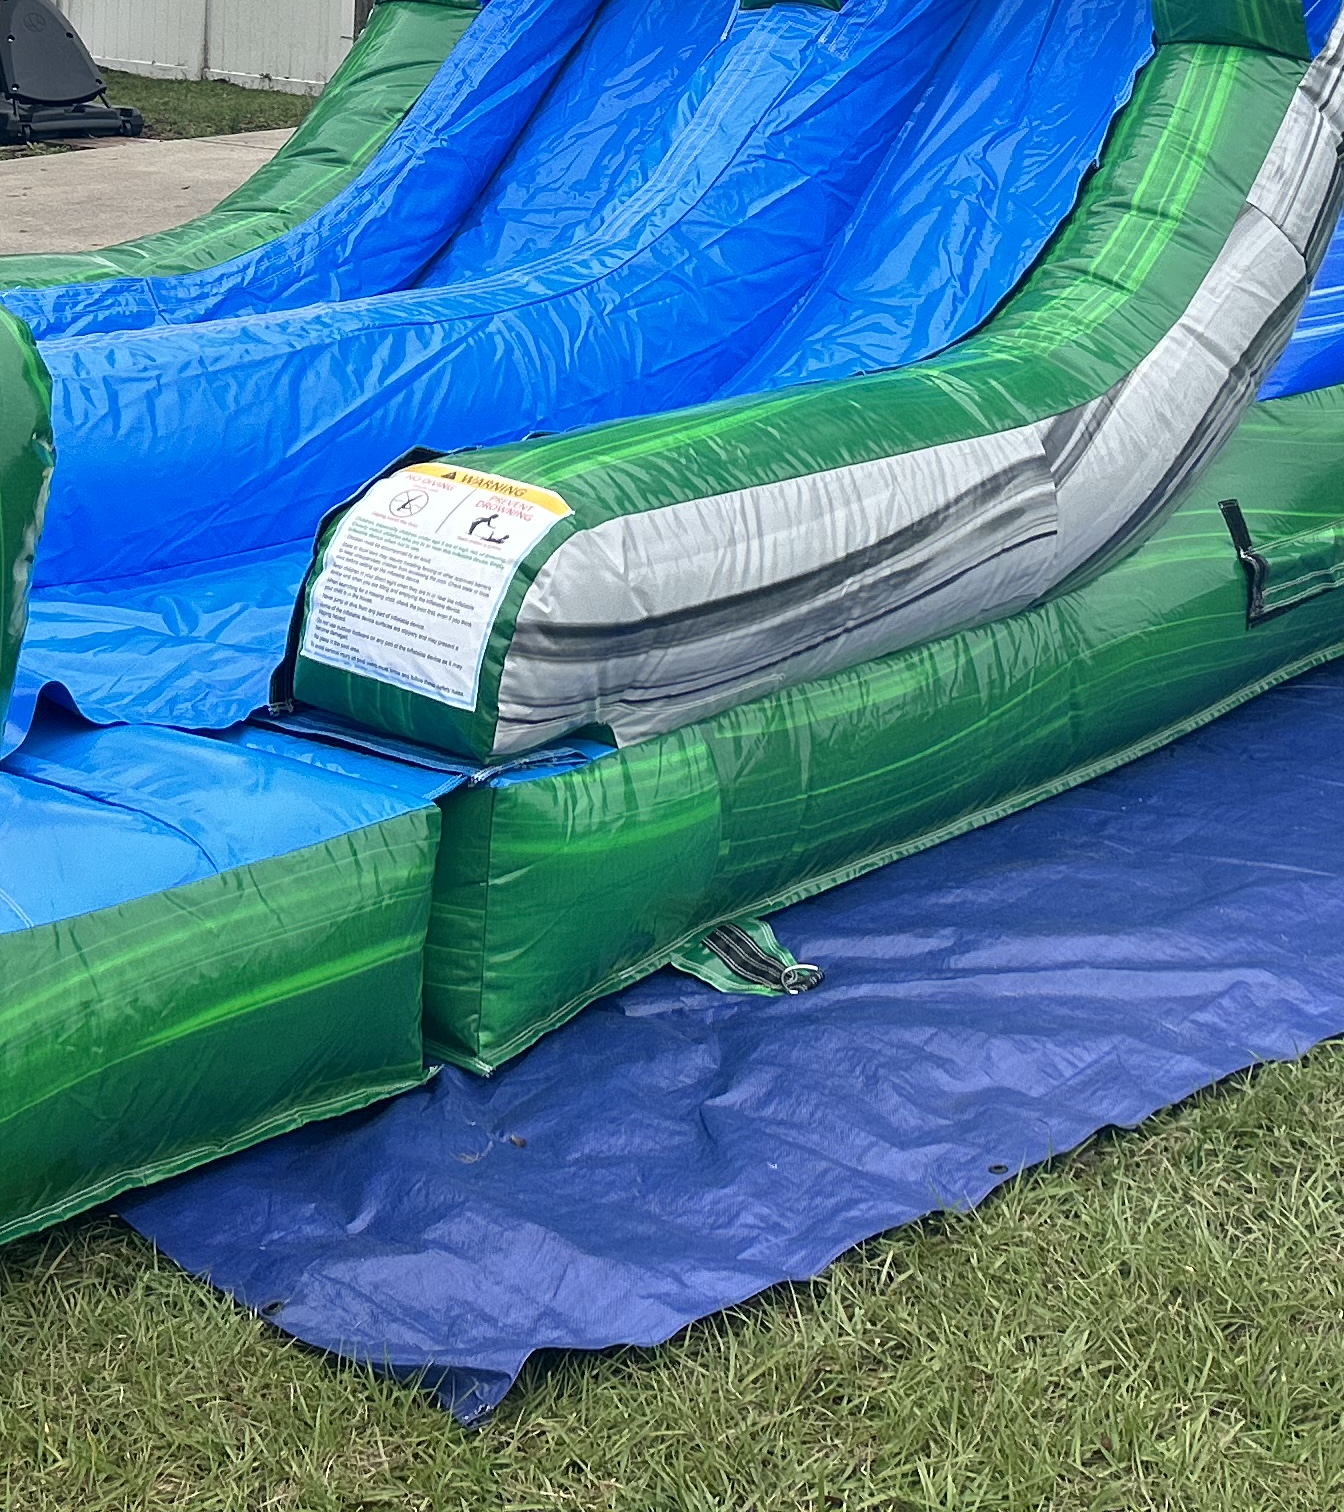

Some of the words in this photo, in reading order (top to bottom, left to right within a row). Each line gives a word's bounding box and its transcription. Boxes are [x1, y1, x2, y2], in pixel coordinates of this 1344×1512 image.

[406, 473, 421, 482] NO
[422, 478, 454, 491] DIVING
[461, 474, 528, 497] WARNING
[475, 500, 532, 522] DROWNING
[490, 496, 535, 512] PREVENT
